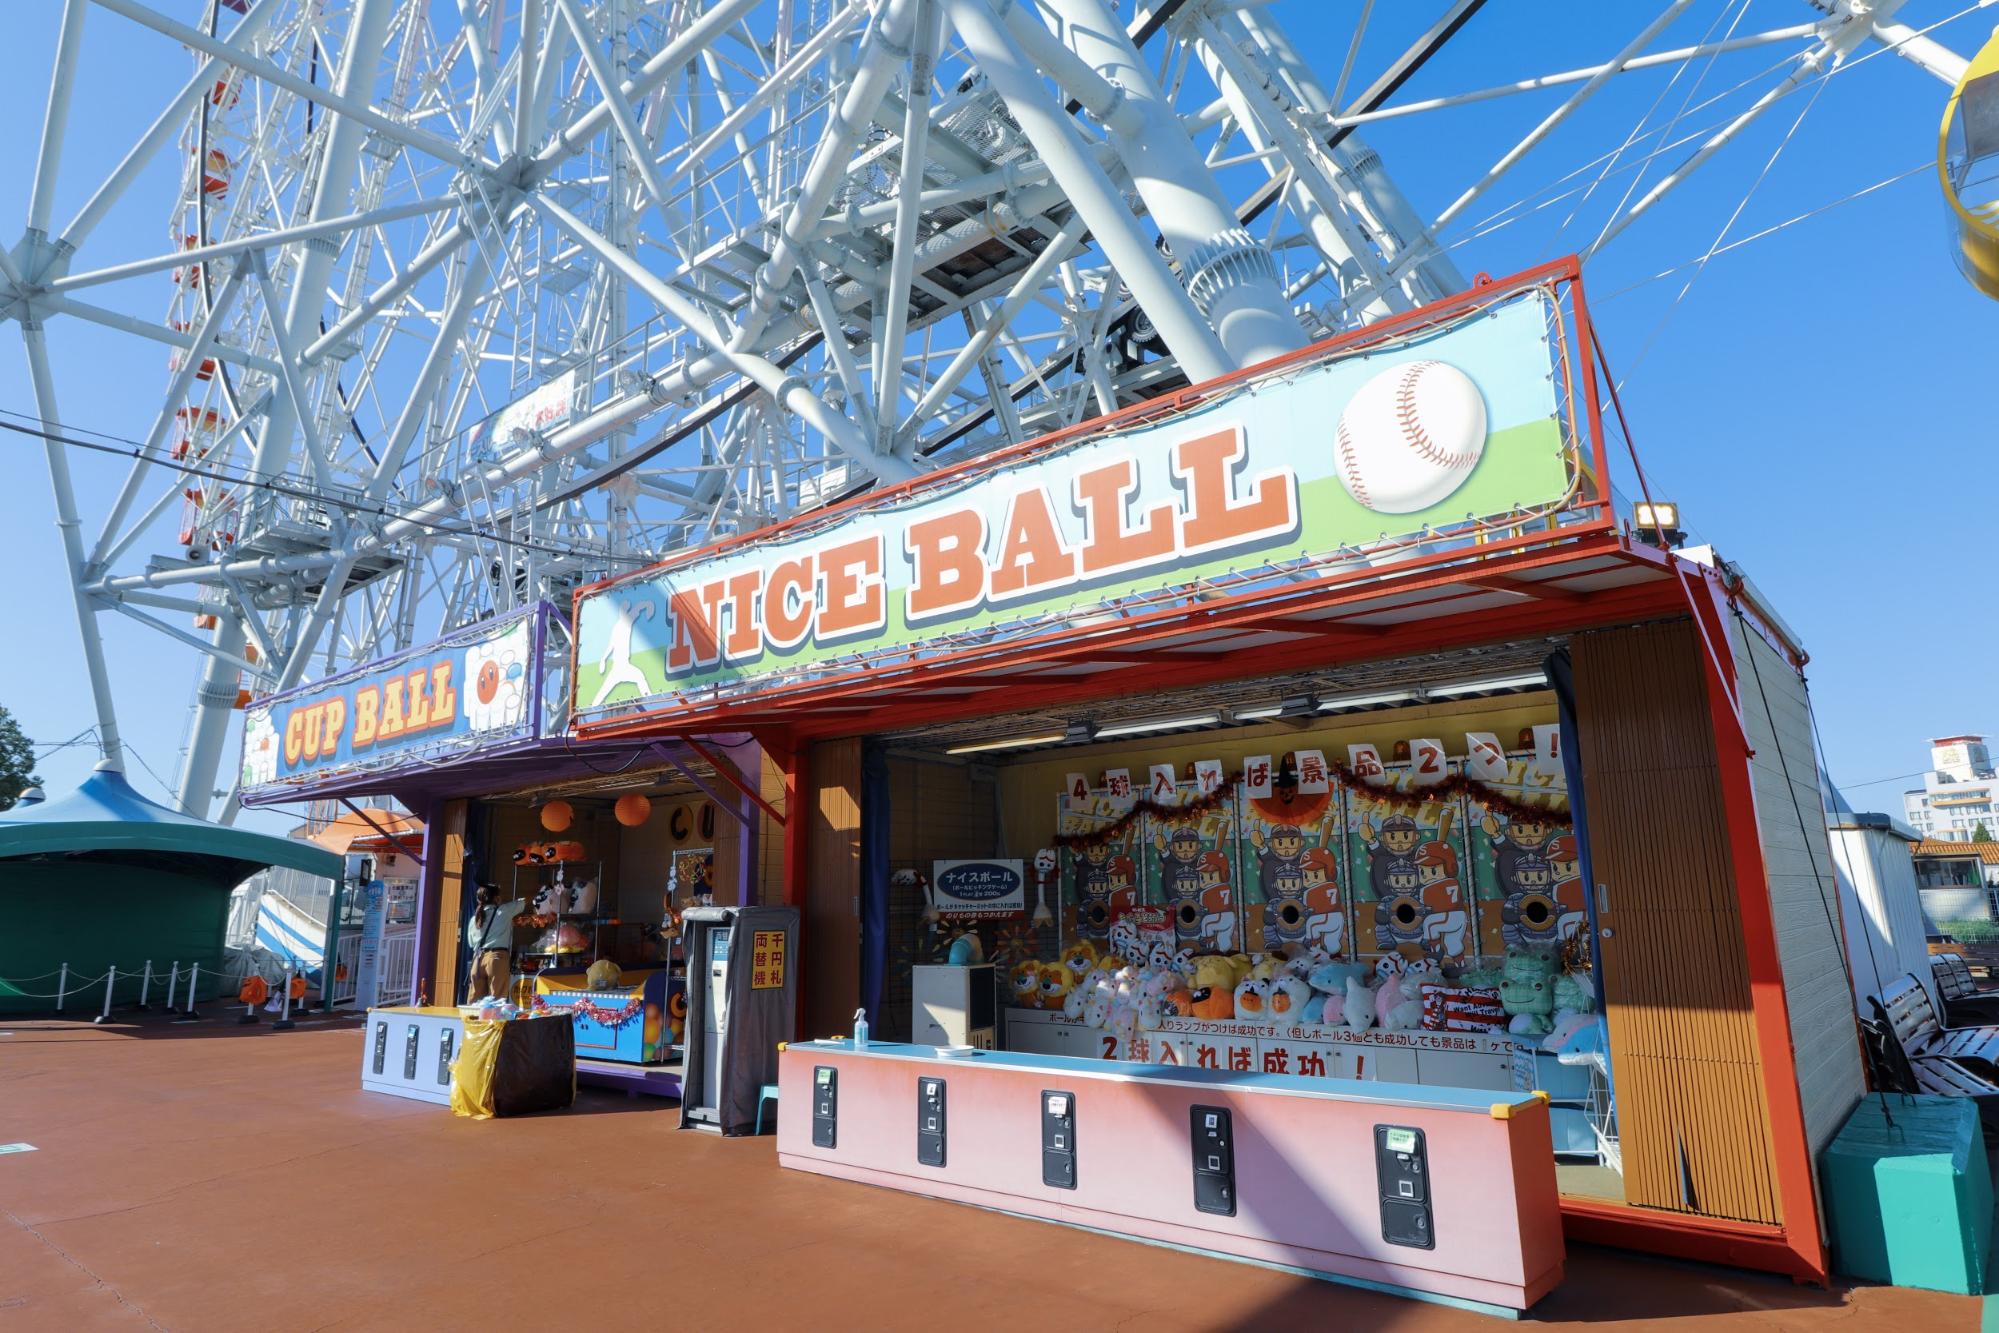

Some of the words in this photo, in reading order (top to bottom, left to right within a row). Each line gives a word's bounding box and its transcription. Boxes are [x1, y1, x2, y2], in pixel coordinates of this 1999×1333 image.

[666, 534, 886, 672] NICE
[904, 421, 1297, 619] BALL
[283, 695, 346, 766] CUP
[351, 659, 456, 748] BALL
[946, 871, 1013, 883] ナイスボール
[1126, 889, 1137, 905] 7
[1219, 888, 1231, 905] 7
[1326, 888, 1338, 905] 7
[1445, 885, 1459, 903] 7
[753, 932, 768, 986] 両替機
[770, 932, 784, 985] 千円札
